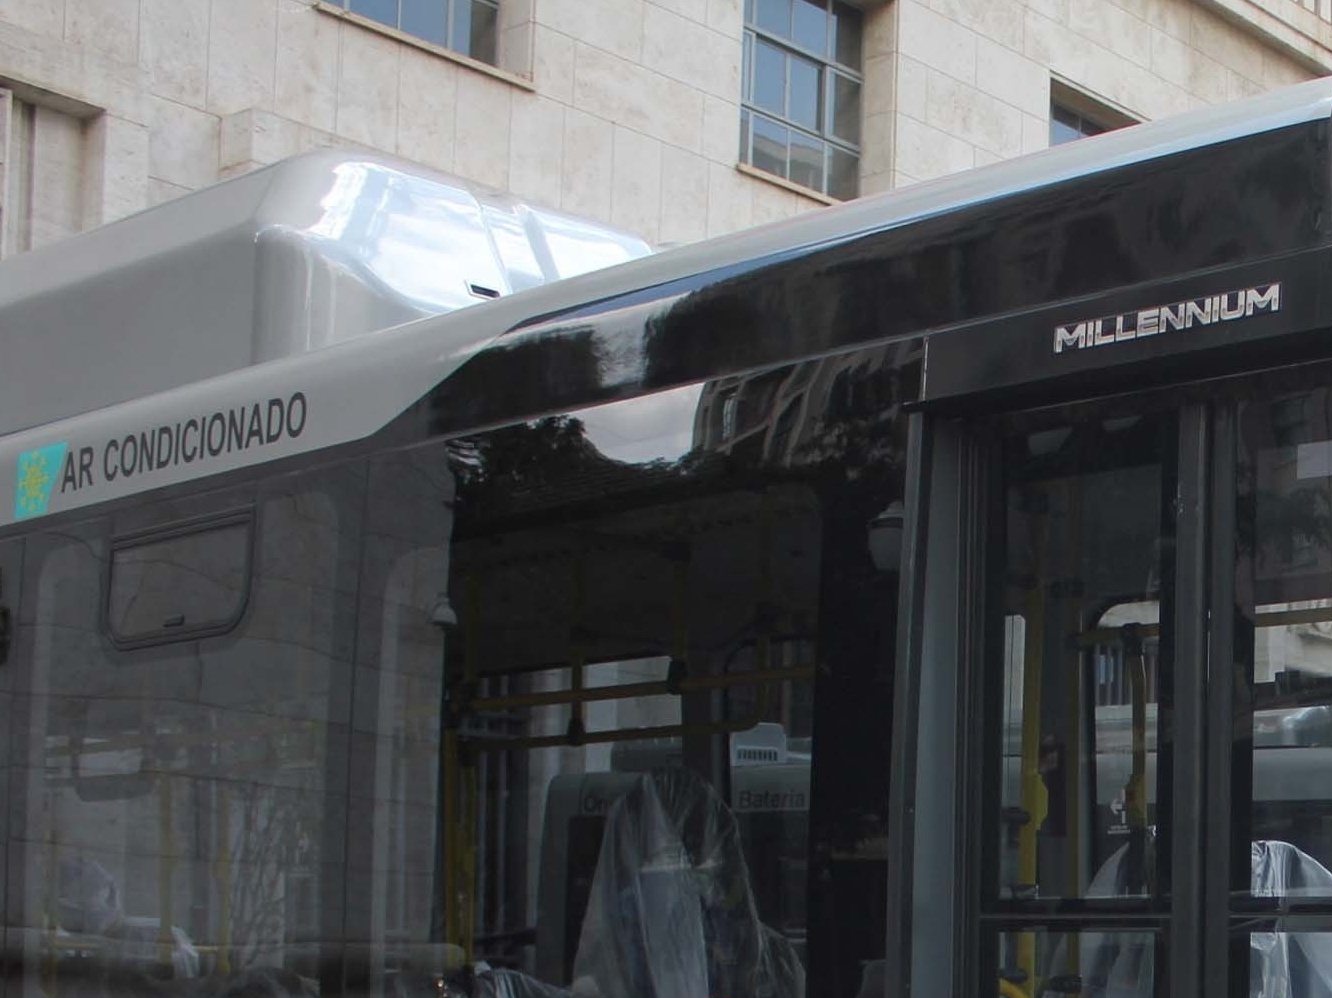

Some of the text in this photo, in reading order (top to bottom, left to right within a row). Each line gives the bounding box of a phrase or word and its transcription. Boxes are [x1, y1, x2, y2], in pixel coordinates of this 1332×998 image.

[1054, 283, 1281, 354] MILLENNIUM
[61, 392, 307, 493] AR CONDICIONADO
